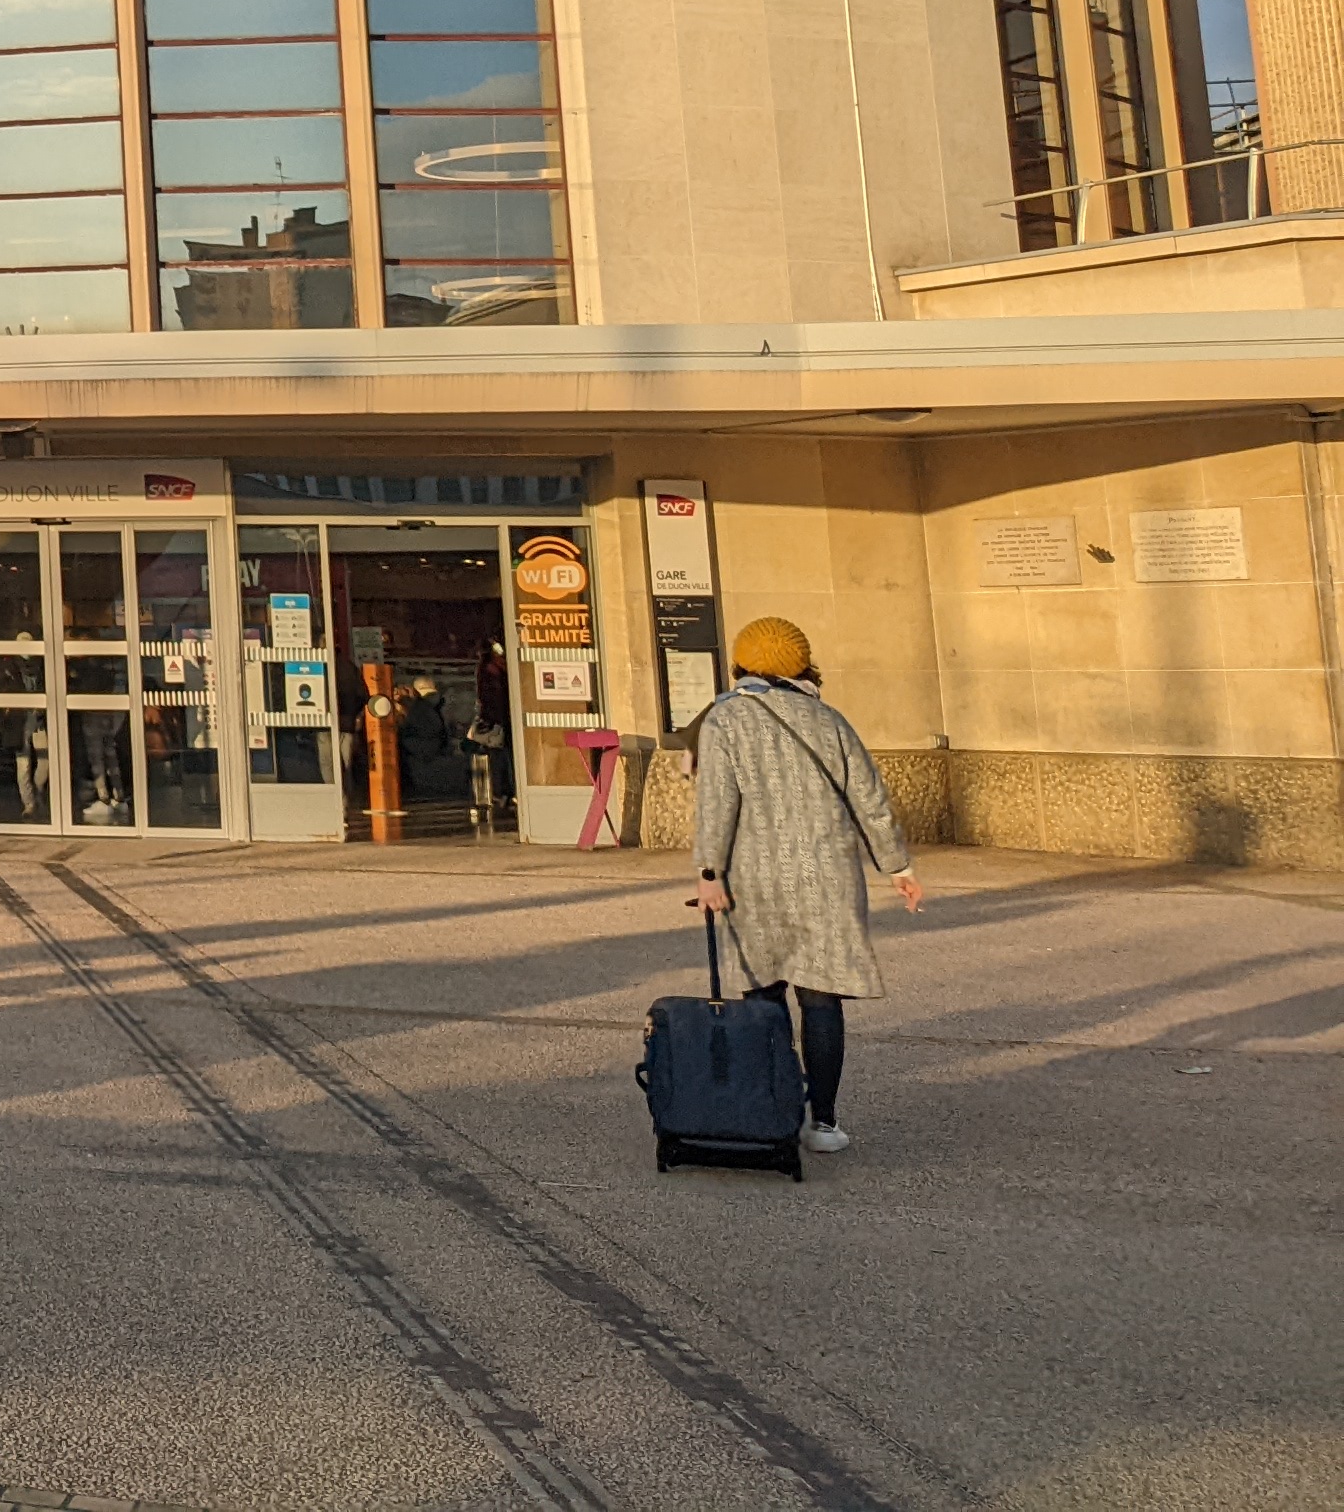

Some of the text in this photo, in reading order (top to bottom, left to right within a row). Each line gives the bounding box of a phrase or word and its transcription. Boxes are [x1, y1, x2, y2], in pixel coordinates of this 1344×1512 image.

[65, 484, 119, 502] VILLE
[147, 483, 194, 500] SNCF
[658, 501, 694, 515] SNCF
[655, 570, 687, 581] GARE
[656, 582, 666, 590] DE
[691, 582, 710, 590] VILLE
[519, 612, 589, 627] GRATUIT
[520, 626, 592, 643] ILLIMITÉ
